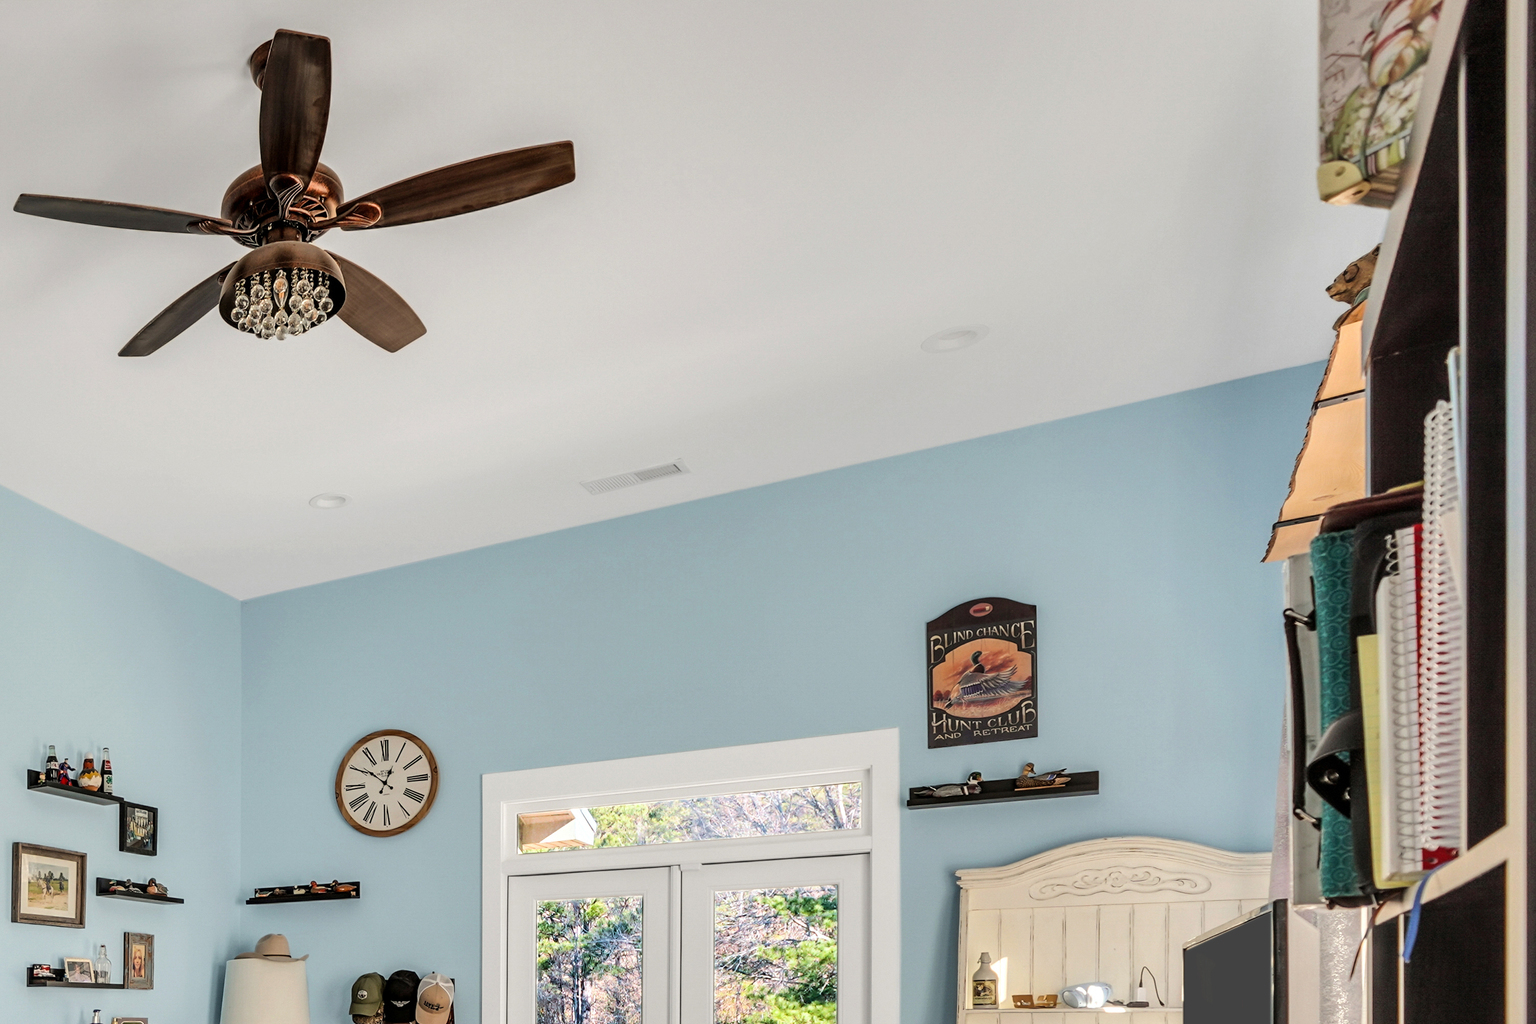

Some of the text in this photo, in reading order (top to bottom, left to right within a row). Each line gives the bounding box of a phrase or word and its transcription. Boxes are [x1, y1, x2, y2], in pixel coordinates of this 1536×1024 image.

[930, 620, 1035, 664] BLIND CHANCE
[931, 701, 1037, 734] HUNT CLUB
[934, 724, 1033, 741] AND RETREAT
